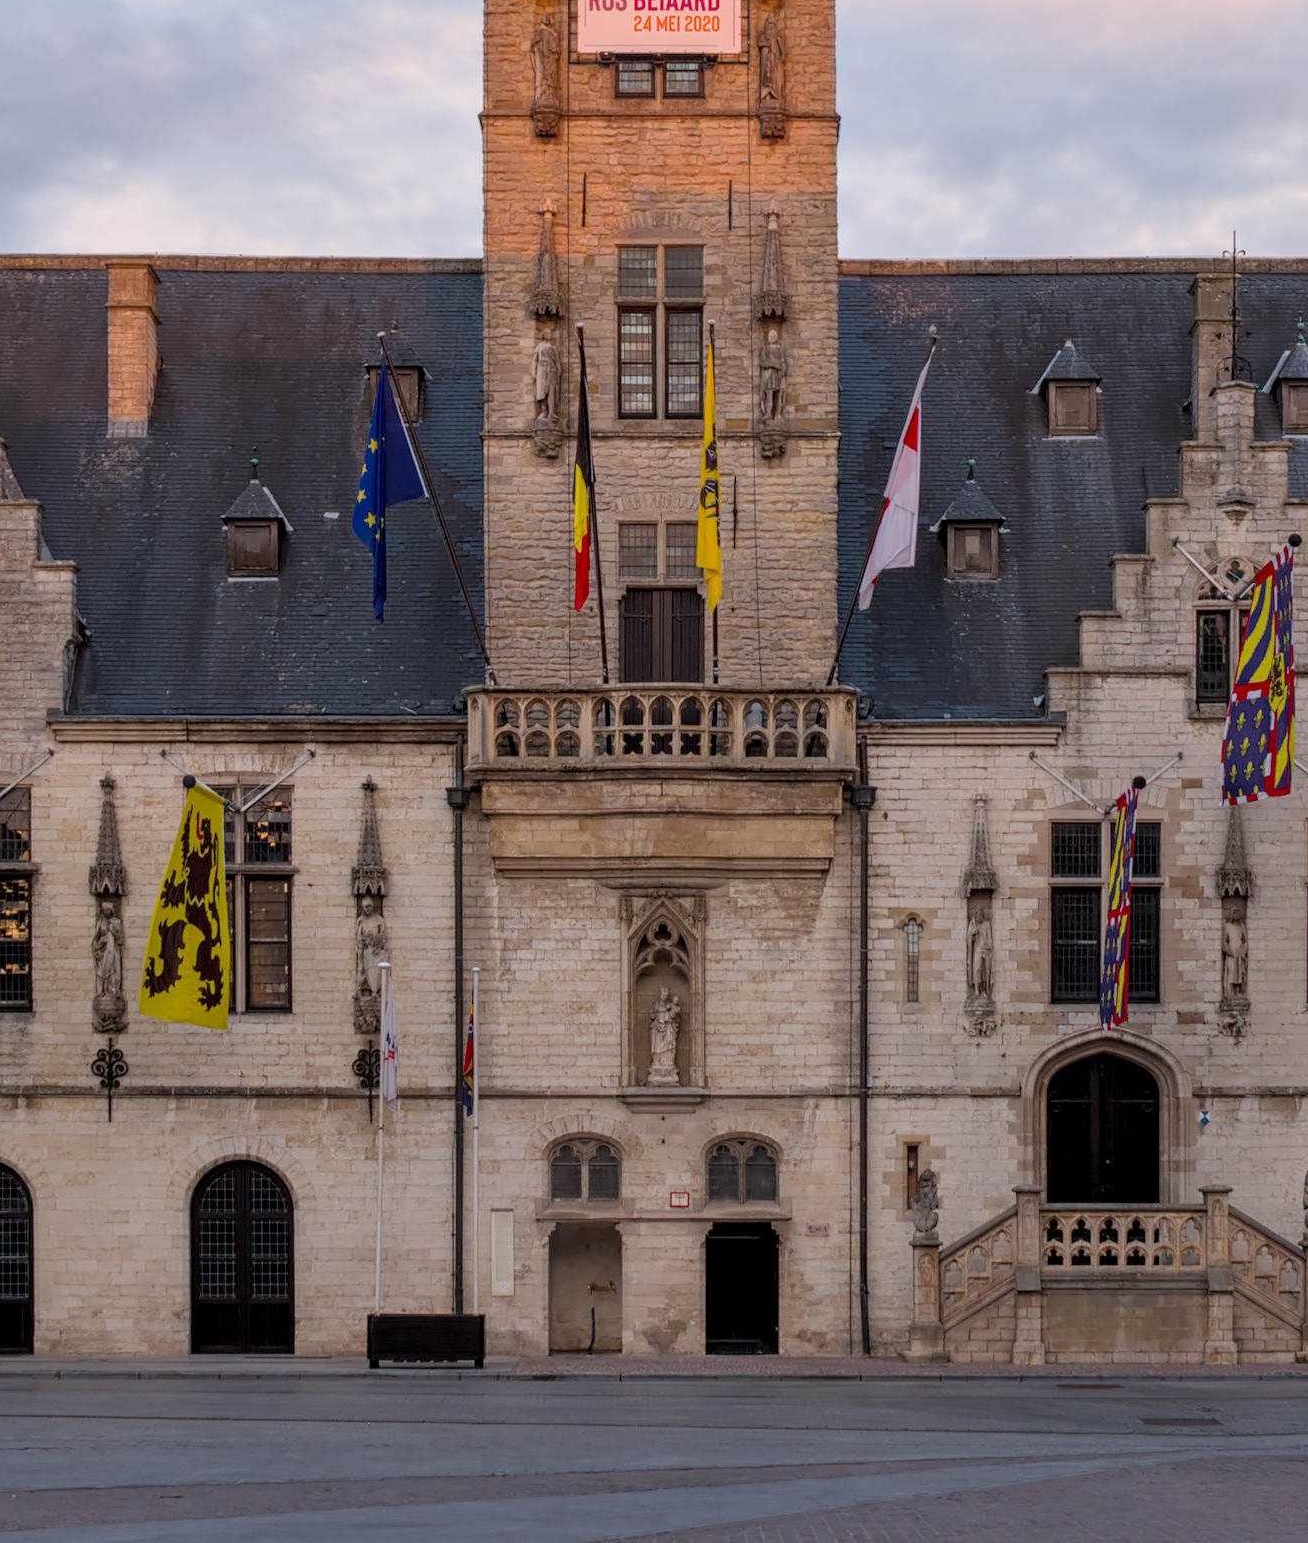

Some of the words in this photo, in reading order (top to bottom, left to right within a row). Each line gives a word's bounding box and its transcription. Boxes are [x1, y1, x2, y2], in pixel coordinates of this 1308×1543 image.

[634, 15, 652, 32] 24
[656, 15, 681, 32] MEI
[684, 15, 720, 32] 2020
